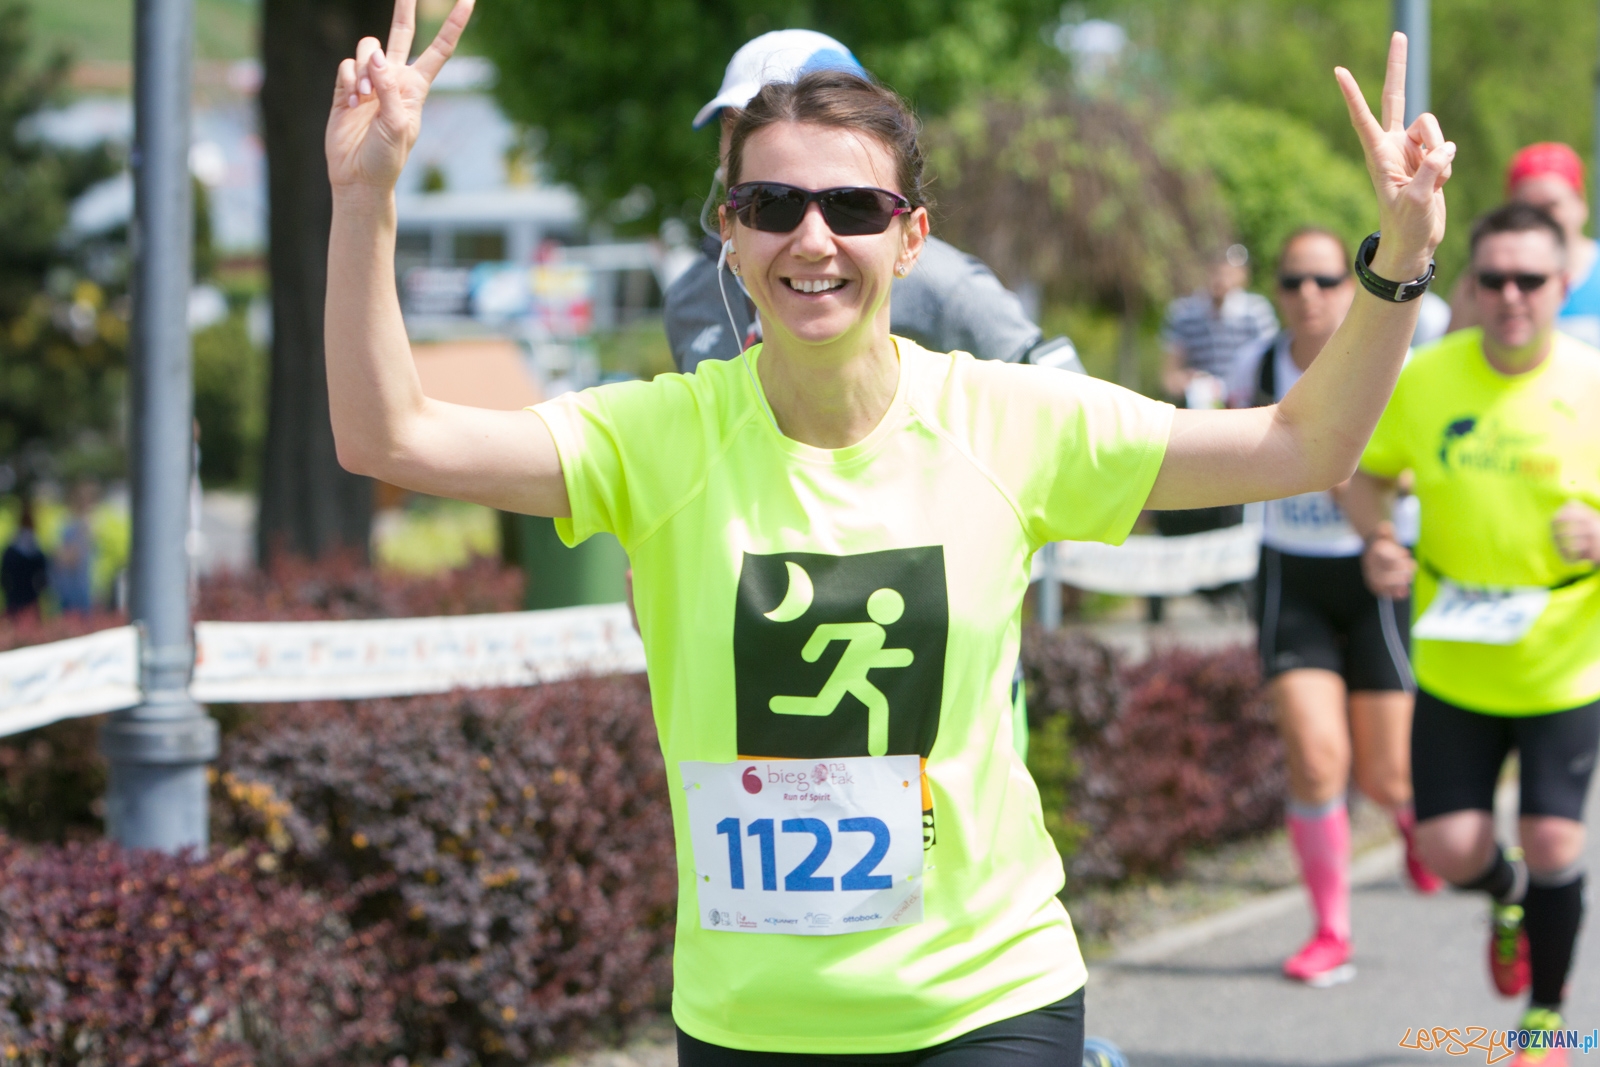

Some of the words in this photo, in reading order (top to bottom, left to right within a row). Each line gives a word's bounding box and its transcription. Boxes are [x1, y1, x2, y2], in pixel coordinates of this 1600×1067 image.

[829, 763, 846, 772] na
[742, 766, 763, 795] 6
[767, 764, 810, 792] bieg
[831, 772, 855, 785] tak
[783, 793, 798, 801] Run
[800, 793, 808, 801] of
[810, 793, 831, 803] Spirit
[716, 816, 893, 892] 1122
